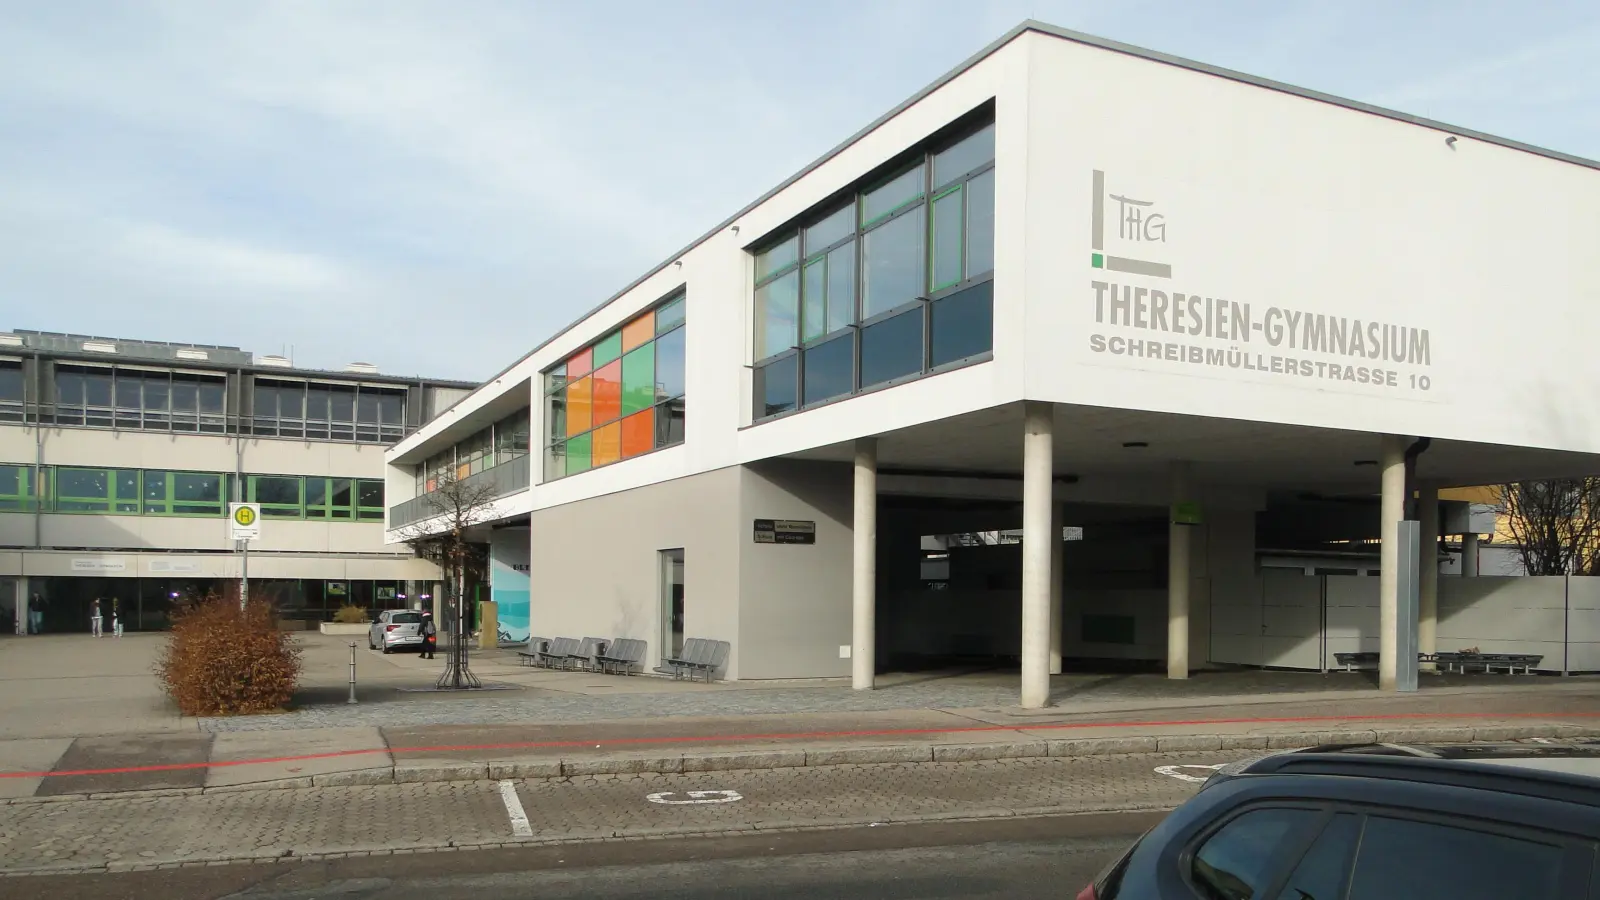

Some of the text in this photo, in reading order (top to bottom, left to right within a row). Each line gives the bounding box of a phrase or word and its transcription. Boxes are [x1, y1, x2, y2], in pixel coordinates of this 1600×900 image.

[1109, 194, 1166, 242] THG
[1091, 280, 1431, 366] THERESIEN-GYMNASIUM
[1090, 333, 1431, 391] SCHREIBMÜLLERSTRASSE 10
[240, 510, 250, 521] H
